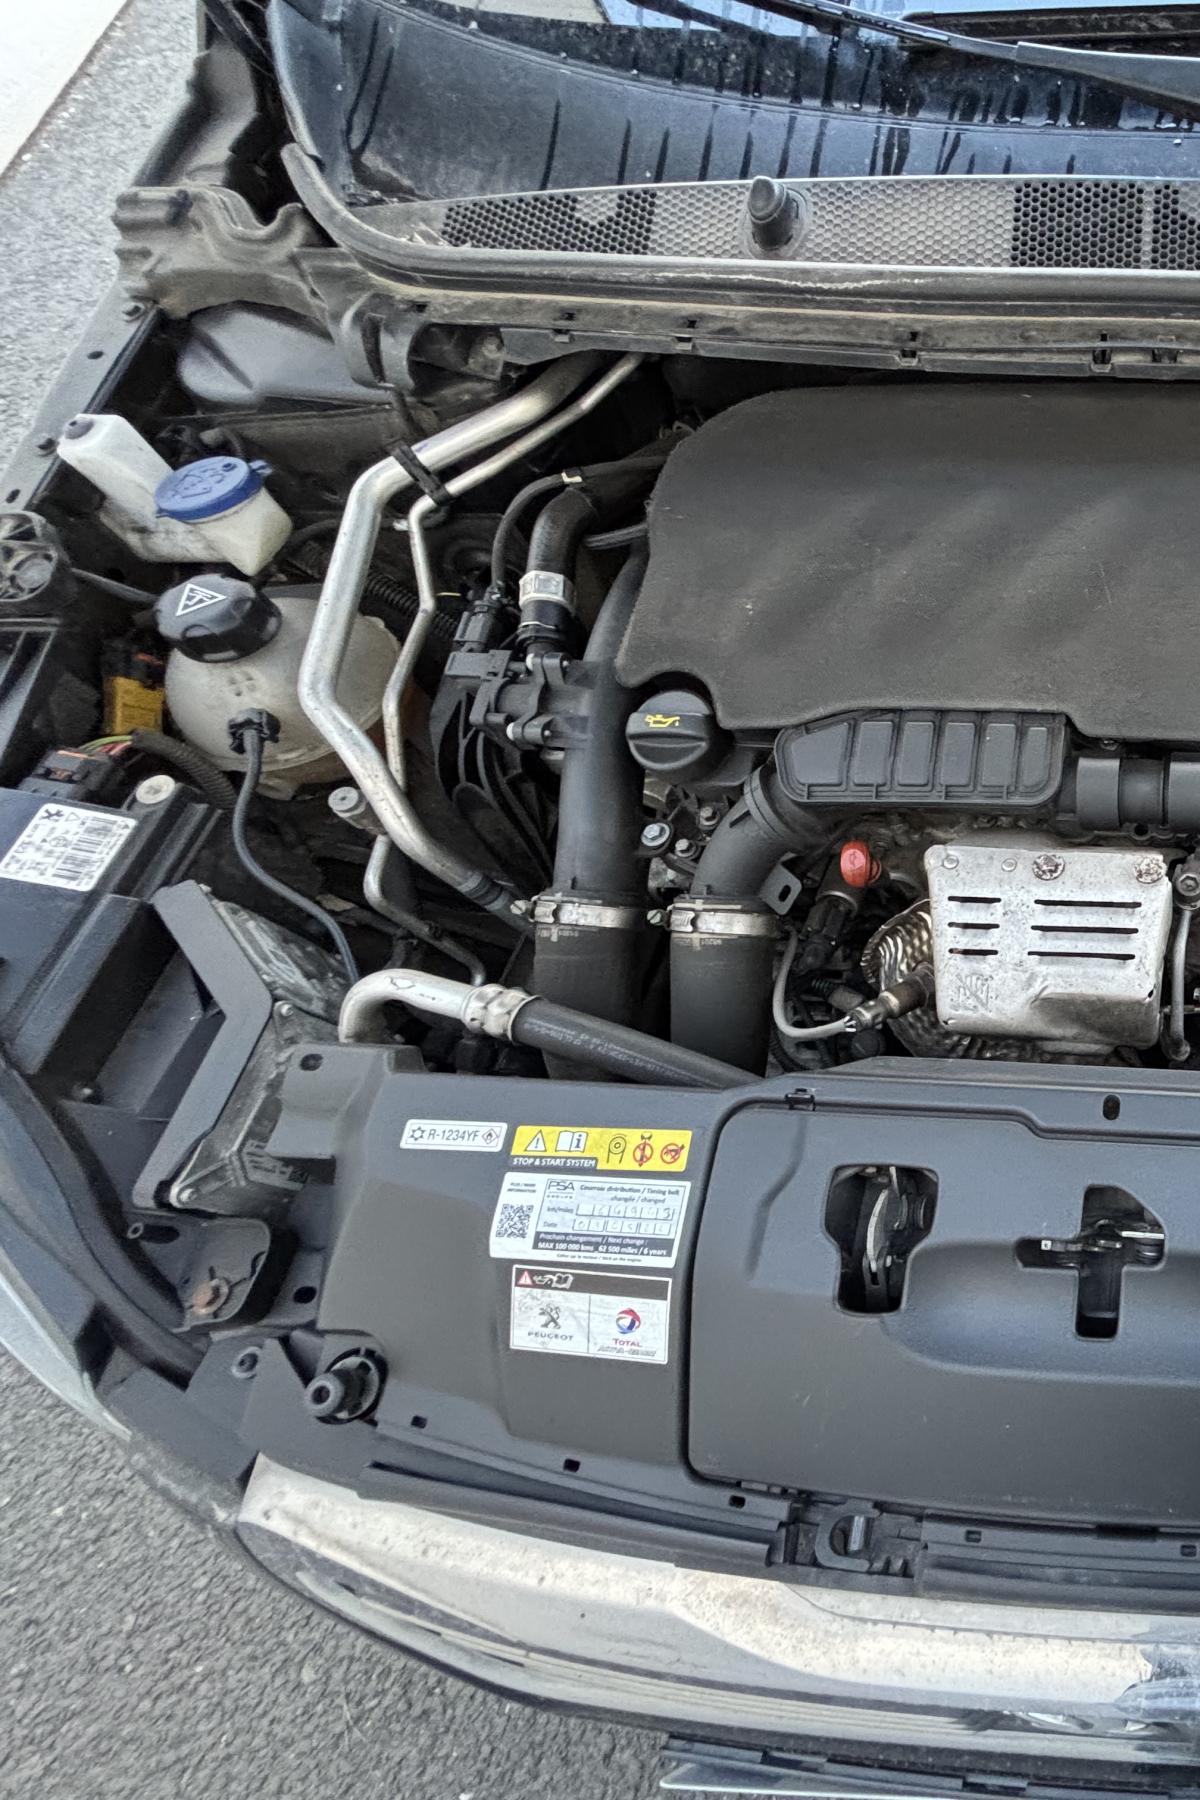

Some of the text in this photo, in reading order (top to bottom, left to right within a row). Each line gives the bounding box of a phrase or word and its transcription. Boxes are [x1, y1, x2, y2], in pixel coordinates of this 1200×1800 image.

[427, 1128, 480, 1141] R-1234YF
[541, 1158, 565, 1166] START
[566, 1159, 597, 1167] SYSTEM
[547, 1180, 575, 1191] PSA
[621, 1246, 638, 1254] miles
[527, 1331, 574, 1341] PEUGEOT
